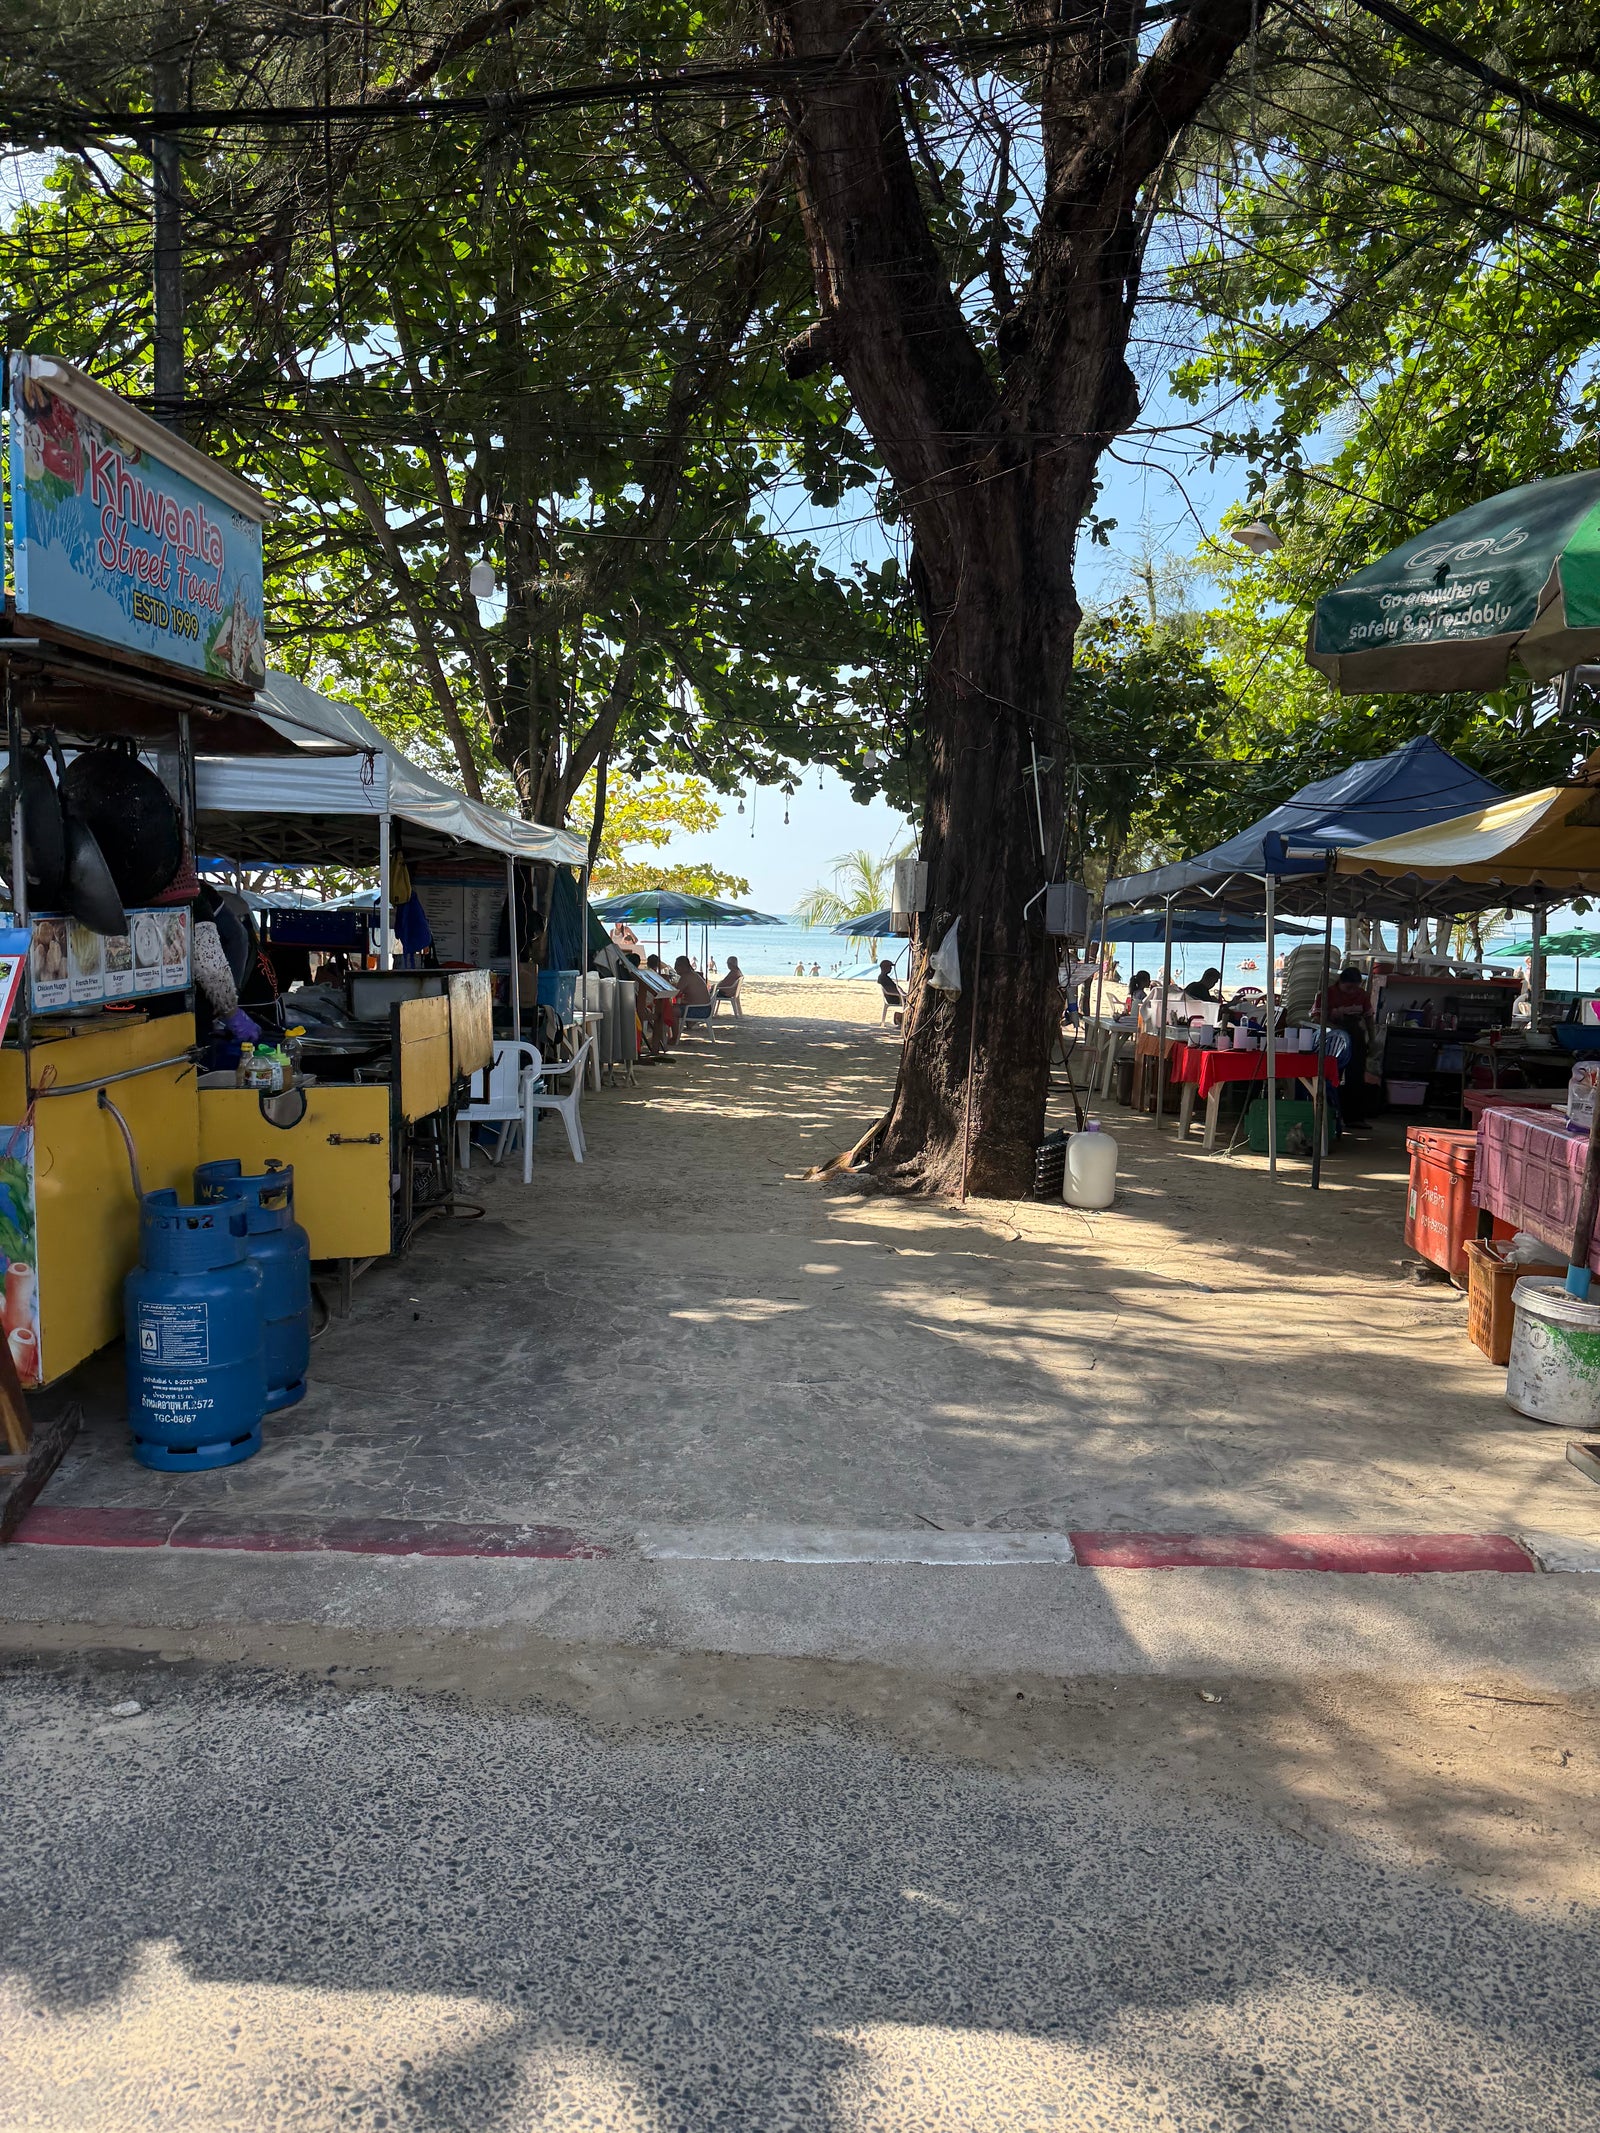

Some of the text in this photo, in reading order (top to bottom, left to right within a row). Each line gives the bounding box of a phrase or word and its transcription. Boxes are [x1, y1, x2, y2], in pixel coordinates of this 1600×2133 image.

[90, 438, 225, 569] Khwanta
[98, 503, 224, 614] Street Food
[1403, 527, 1529, 570] Grab
[132, 589, 199, 639] ESTD 1999
[1379, 579, 1491, 610] Go anywhere
[1349, 602, 1512, 640] safely & affordably
